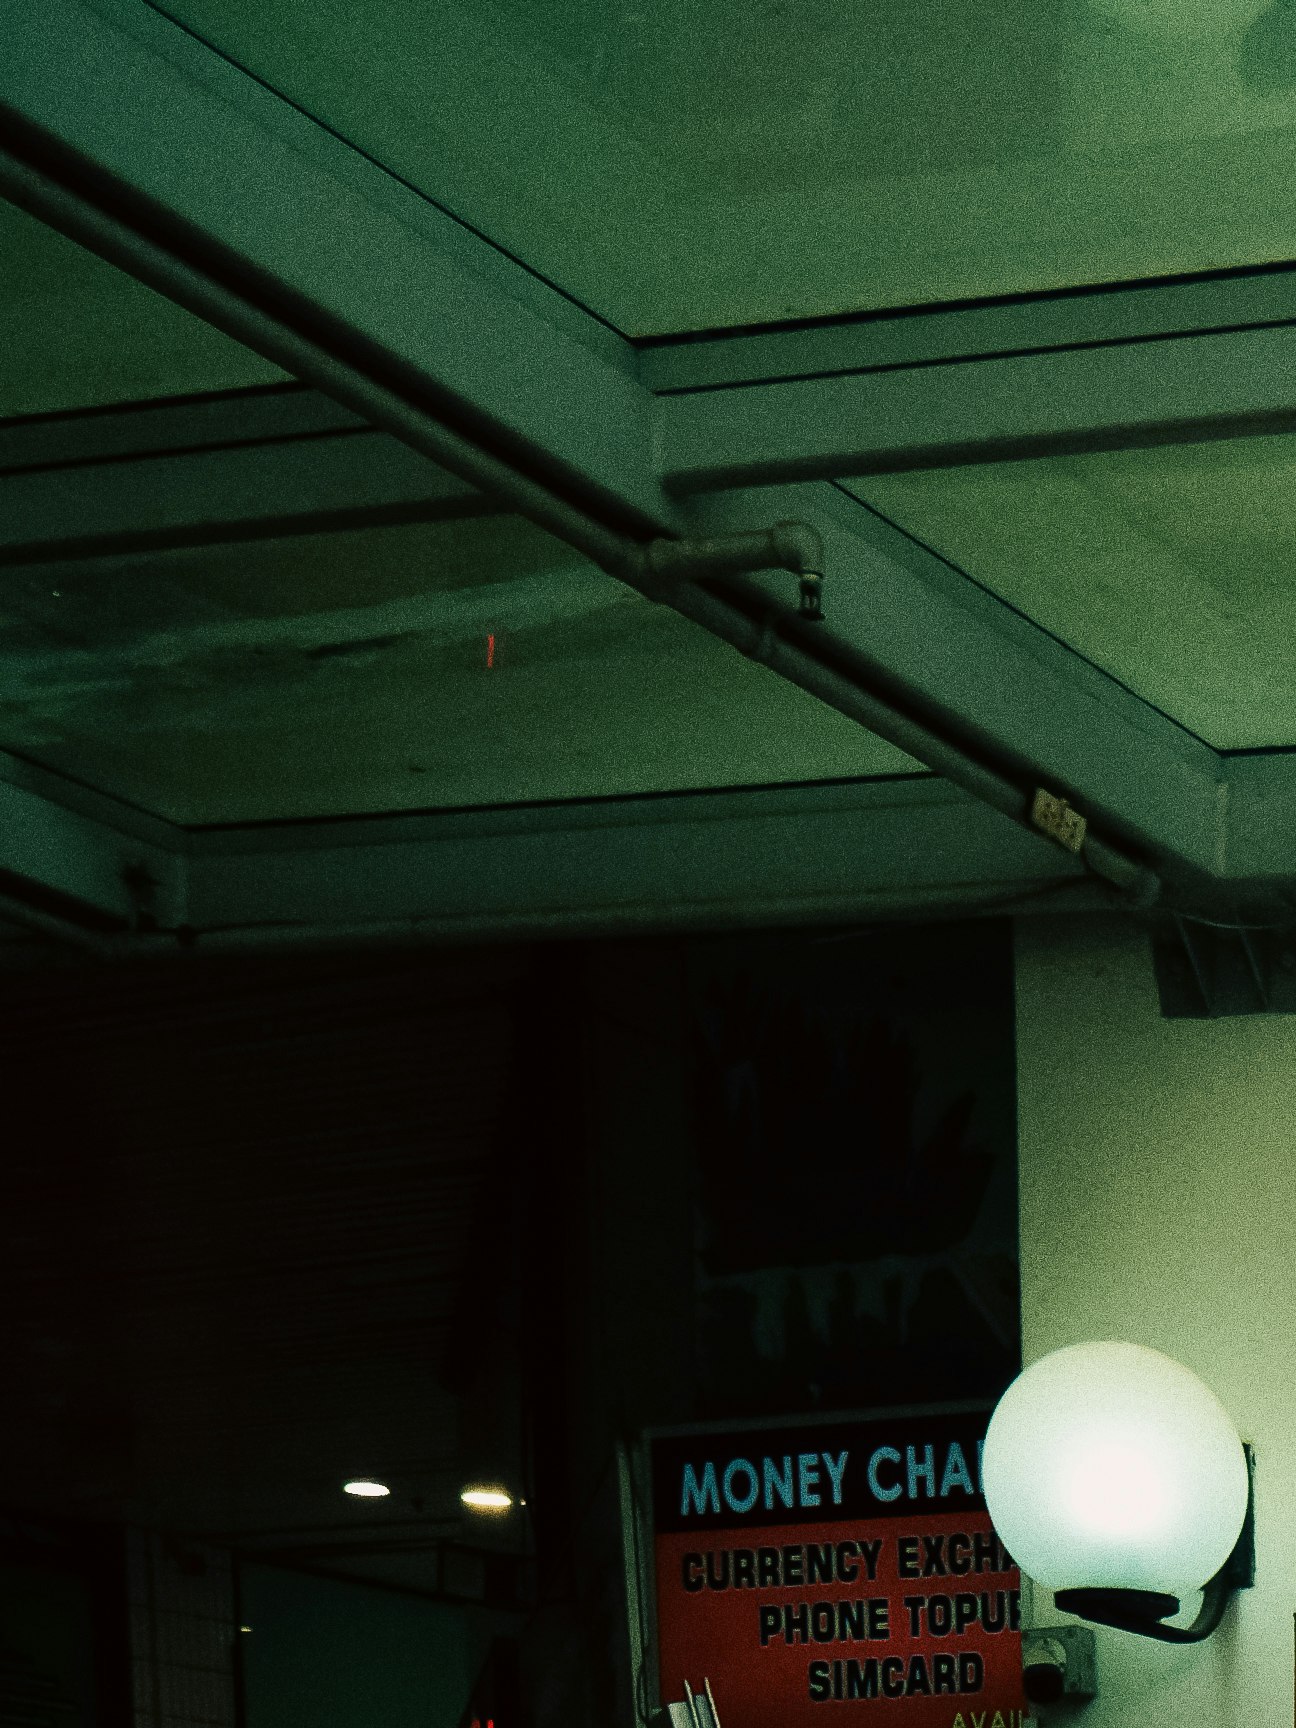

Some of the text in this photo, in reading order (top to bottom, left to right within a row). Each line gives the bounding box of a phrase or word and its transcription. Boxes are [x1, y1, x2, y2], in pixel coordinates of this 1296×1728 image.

[681, 1441, 984, 1516] MONEY CHA
[682, 1539, 882, 1594] CURRENCY
[760, 1597, 889, 1647] PHONE
[809, 1653, 984, 1703] SIMCARD
